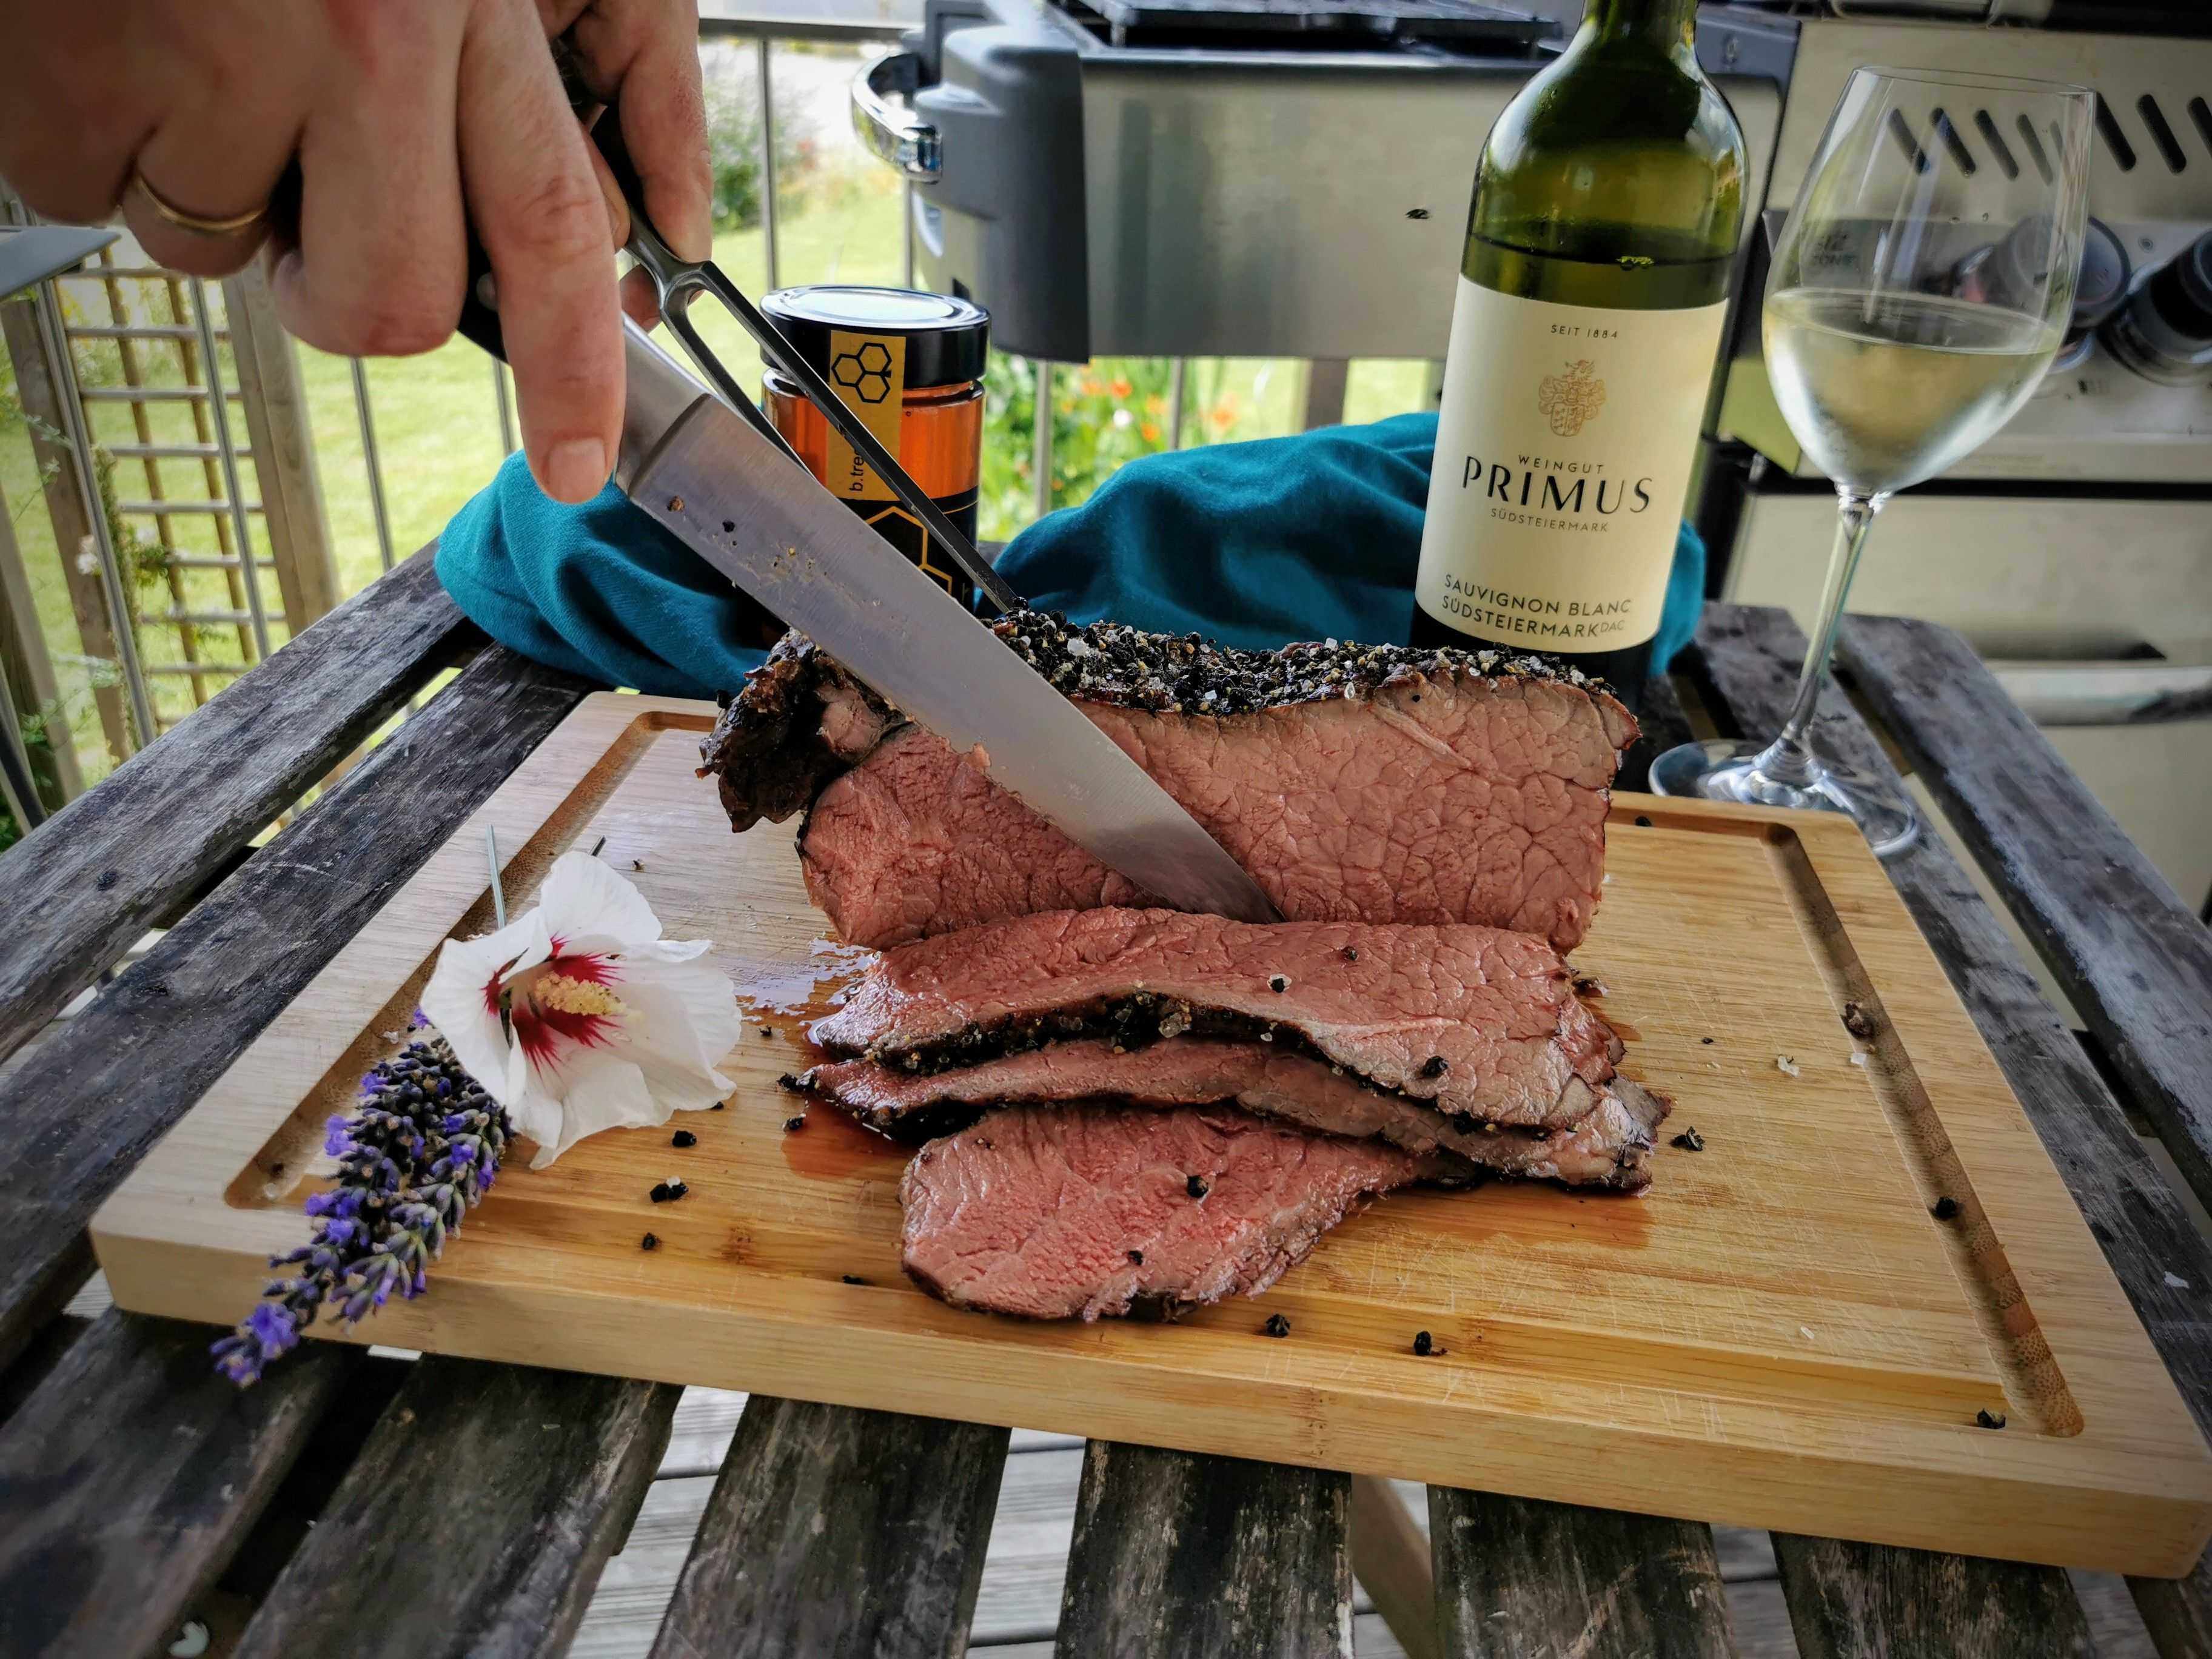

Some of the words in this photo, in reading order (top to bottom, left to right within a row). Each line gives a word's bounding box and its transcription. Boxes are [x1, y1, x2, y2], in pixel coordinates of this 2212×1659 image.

[1550, 324, 1580, 337] SEIT
[1587, 328, 1618, 339] 1884
[849, 449, 864, 492] b.tre
[1462, 455, 1653, 515] PRIMUS
[1518, 454, 1604, 475] WEINGUT
[1490, 508, 1608, 532] SÜDSTEIERMARK
[1441, 595, 1600, 637] SÜDSTEIERMARK
[1444, 574, 1560, 615] SAUVIGNON
[1568, 599, 1632, 617] BLANC
